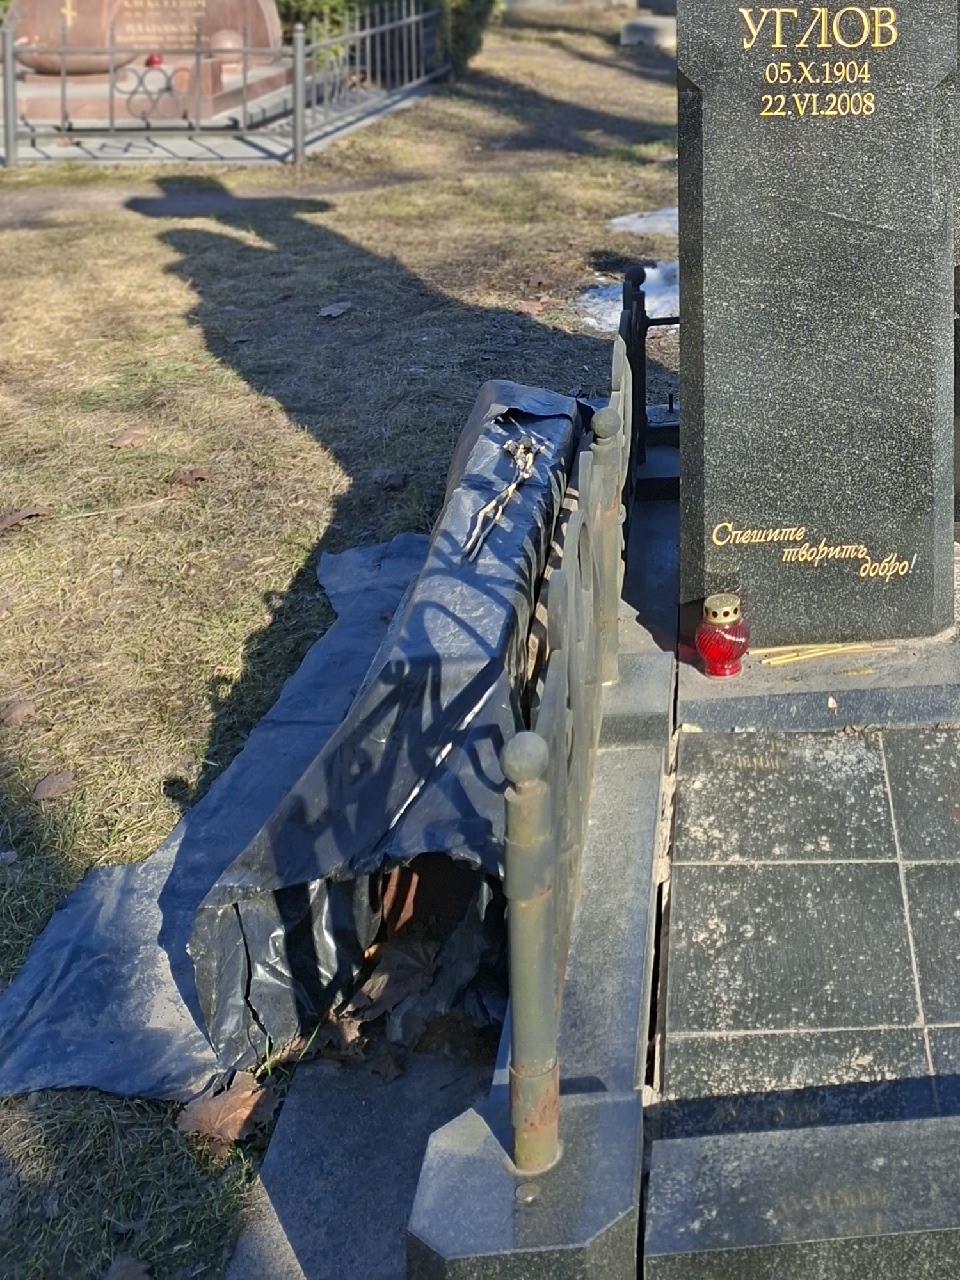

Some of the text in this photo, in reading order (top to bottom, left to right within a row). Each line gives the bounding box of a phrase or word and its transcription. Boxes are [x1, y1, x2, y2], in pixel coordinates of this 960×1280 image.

[739, 7, 898, 49] УГЛОВ
[712, 521, 806, 546] Спешите
[782, 538, 868, 567] творить
[860, 553, 917, 582] добро!
